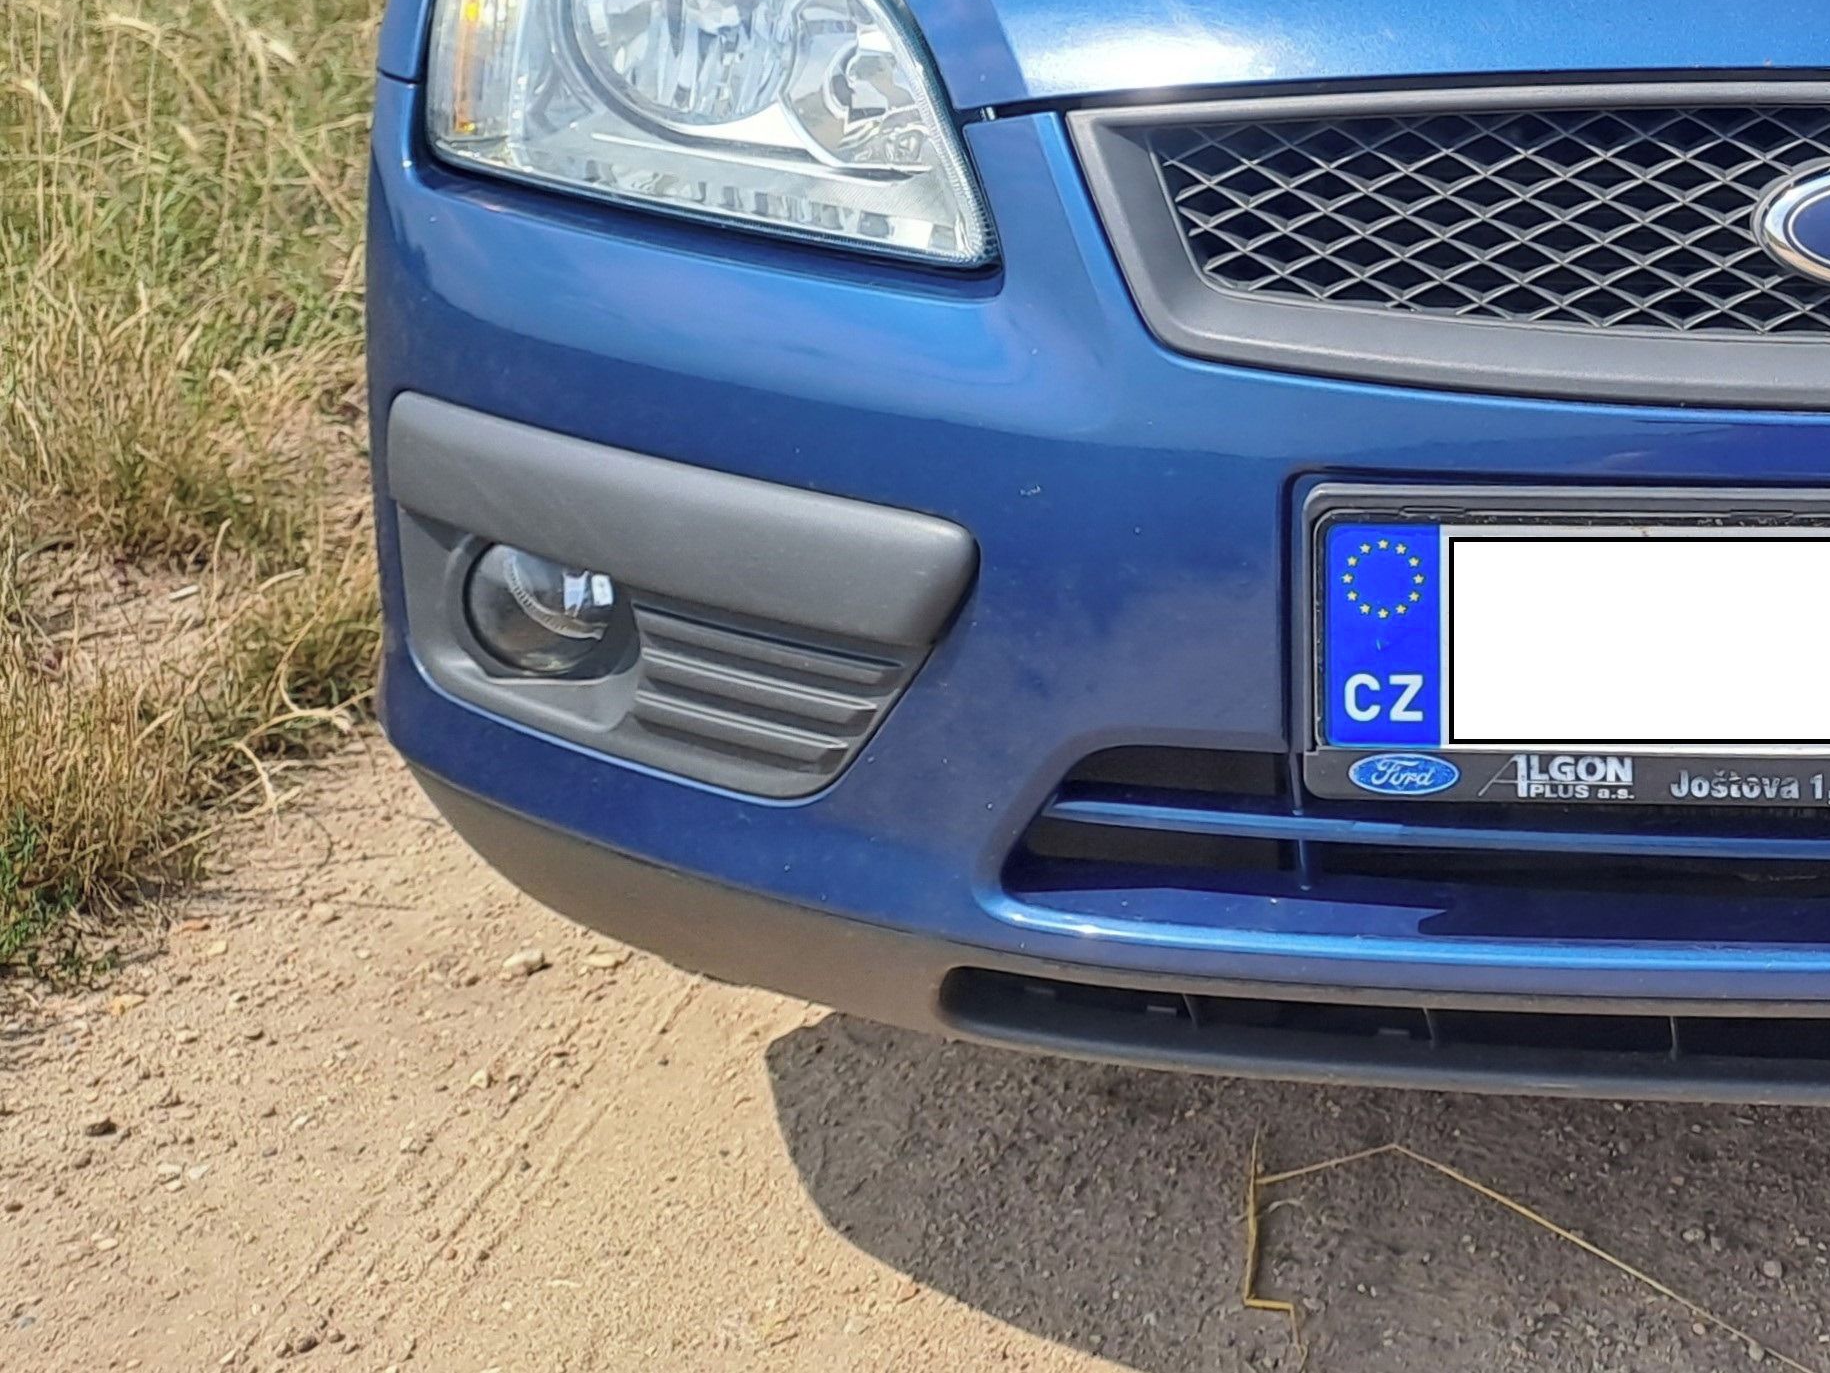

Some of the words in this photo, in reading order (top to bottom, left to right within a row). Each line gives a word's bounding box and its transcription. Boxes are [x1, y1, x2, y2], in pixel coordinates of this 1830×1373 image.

[1344, 673, 1424, 722] CZ
[1371, 760, 1434, 786] Ford
[1478, 754, 1633, 797] ALGON
[1530, 784, 1589, 799] PLUS
[1597, 786, 1635, 799] a.s.
